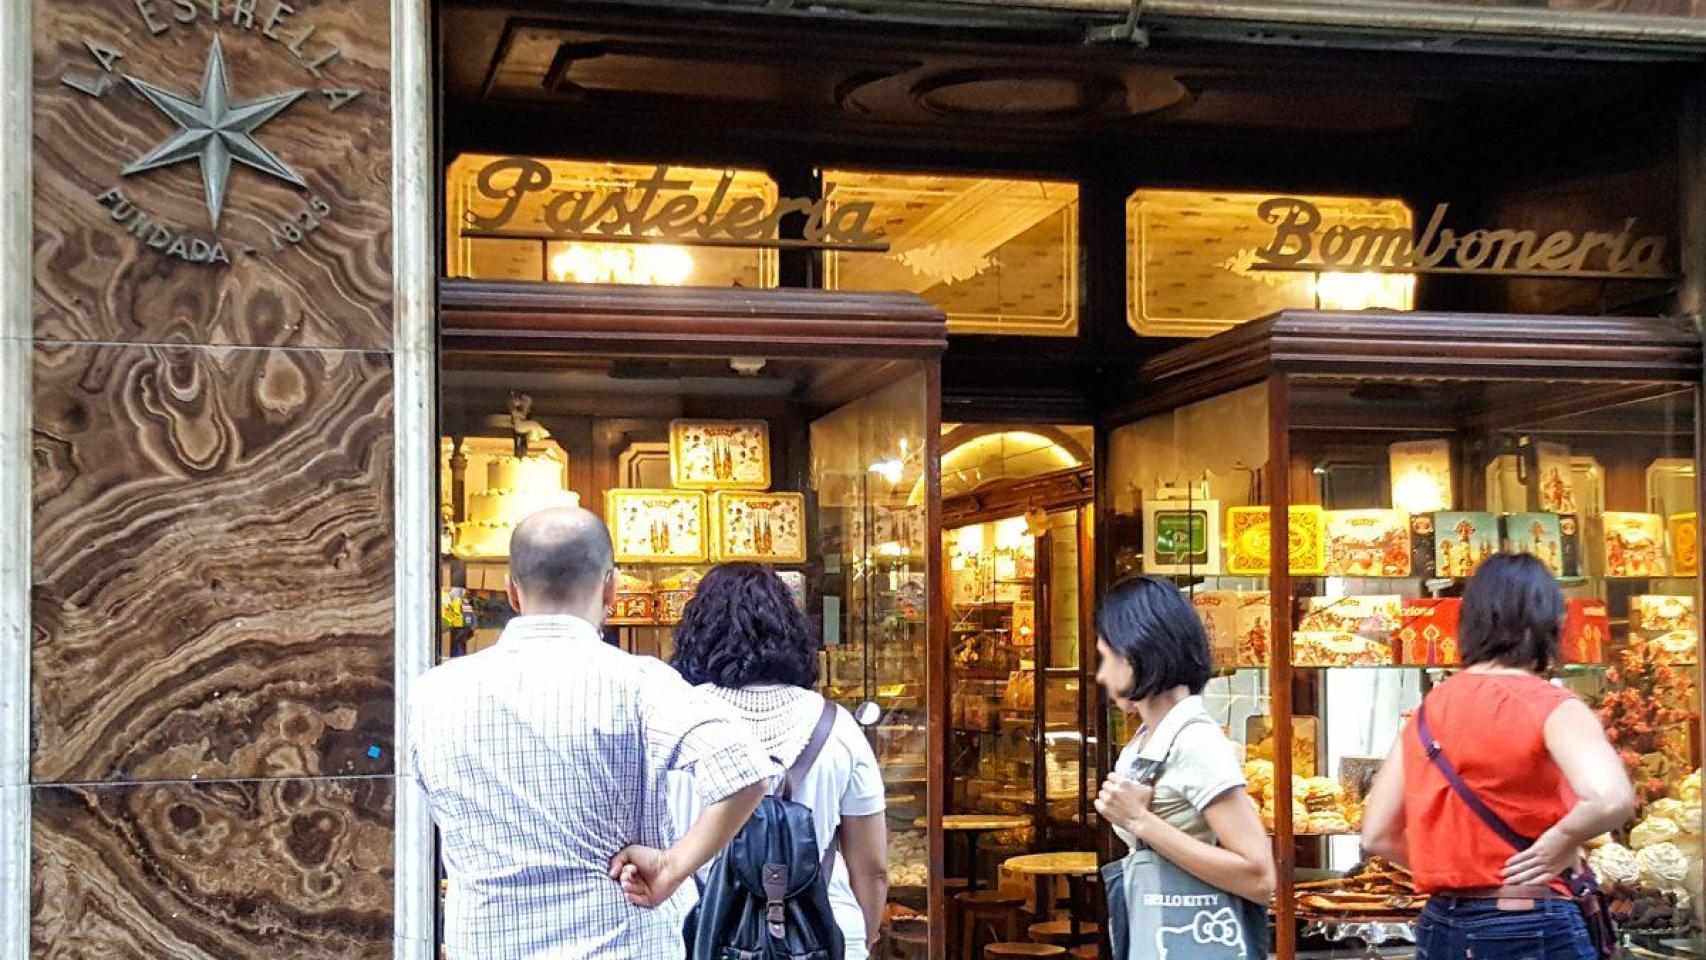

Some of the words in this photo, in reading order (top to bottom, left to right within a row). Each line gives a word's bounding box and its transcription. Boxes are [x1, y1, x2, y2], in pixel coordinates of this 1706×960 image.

[61, 36, 124, 98] LA
[97, 186, 230, 265] FUNDADA
[270, 195, 331, 250] 1825
[464, 157, 886, 242] Pastelería
[1257, 197, 1668, 272] Bombonería
[1143, 893, 1181, 906] HELLO
[1183, 894, 1219, 906] KITTY
